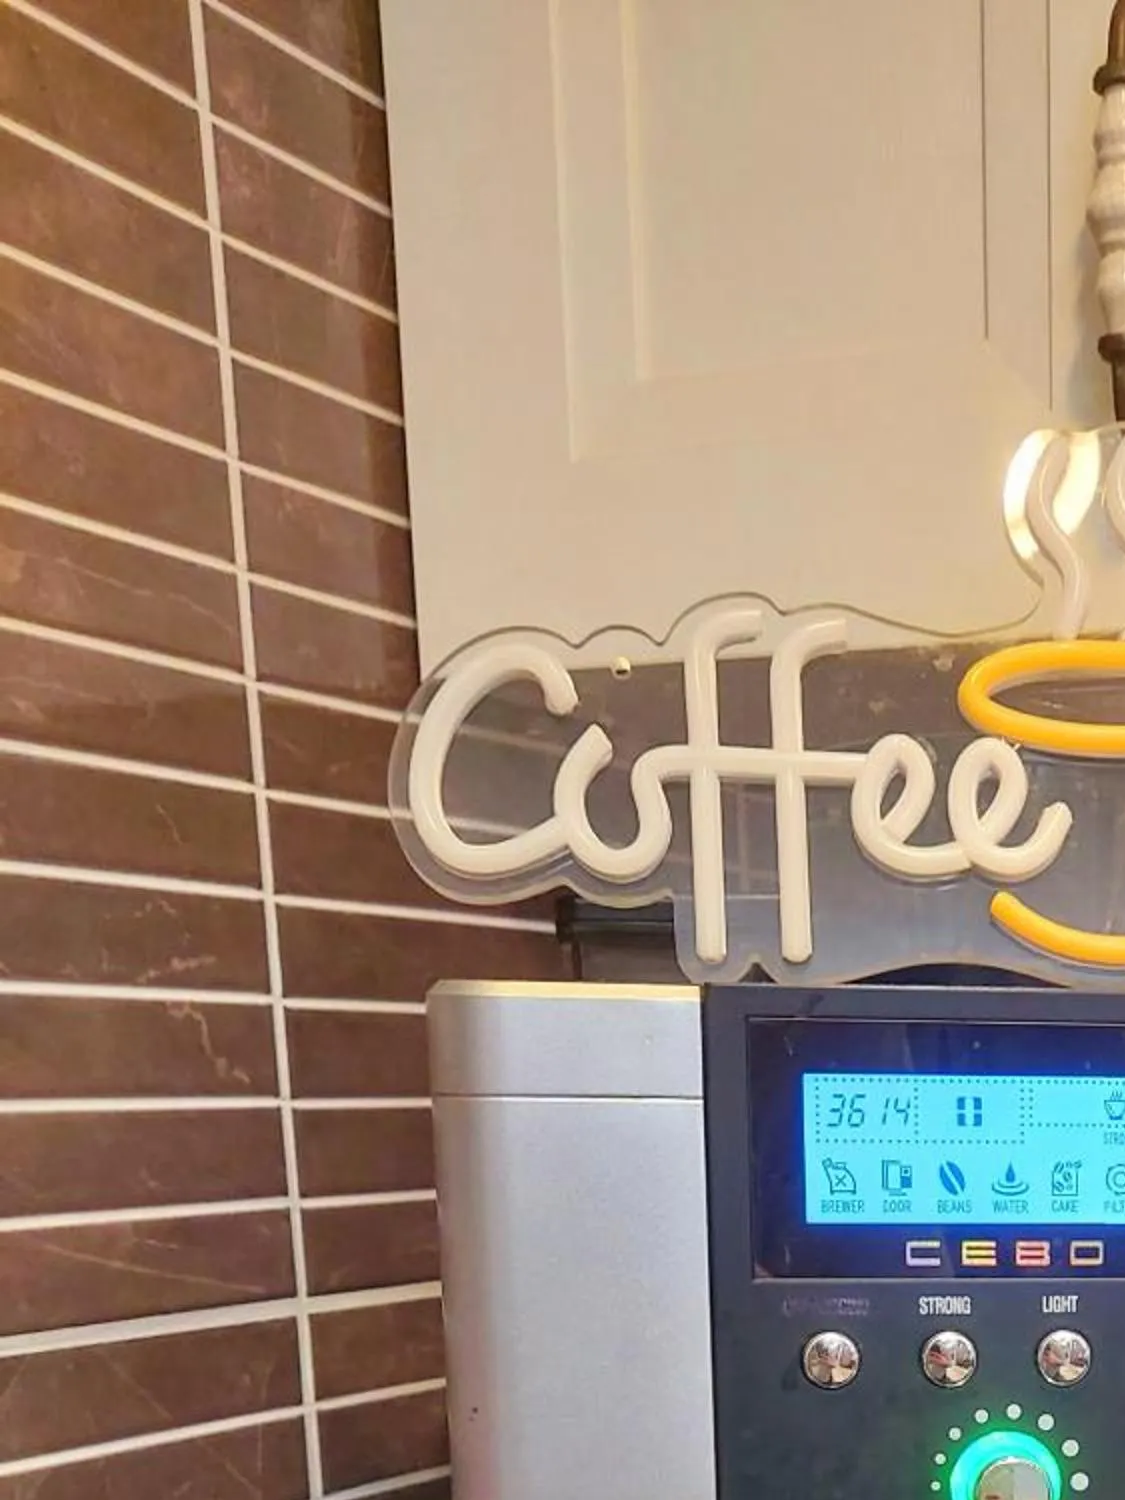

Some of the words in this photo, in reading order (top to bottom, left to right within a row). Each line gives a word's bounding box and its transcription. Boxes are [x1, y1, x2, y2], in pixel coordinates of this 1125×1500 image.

[408, 607, 1074, 965] Coffee
[820, 1199, 866, 1214] BREWER
[882, 1199, 913, 1214] DOOR
[937, 1199, 973, 1214] BEANS
[992, 1199, 1030, 1214] WATER
[1051, 1199, 1080, 1214] CAKE
[905, 1240, 1105, 1267] CEBO
[918, 1295, 972, 1315] STRONG
[1041, 1295, 1079, 1314] LIGHT
